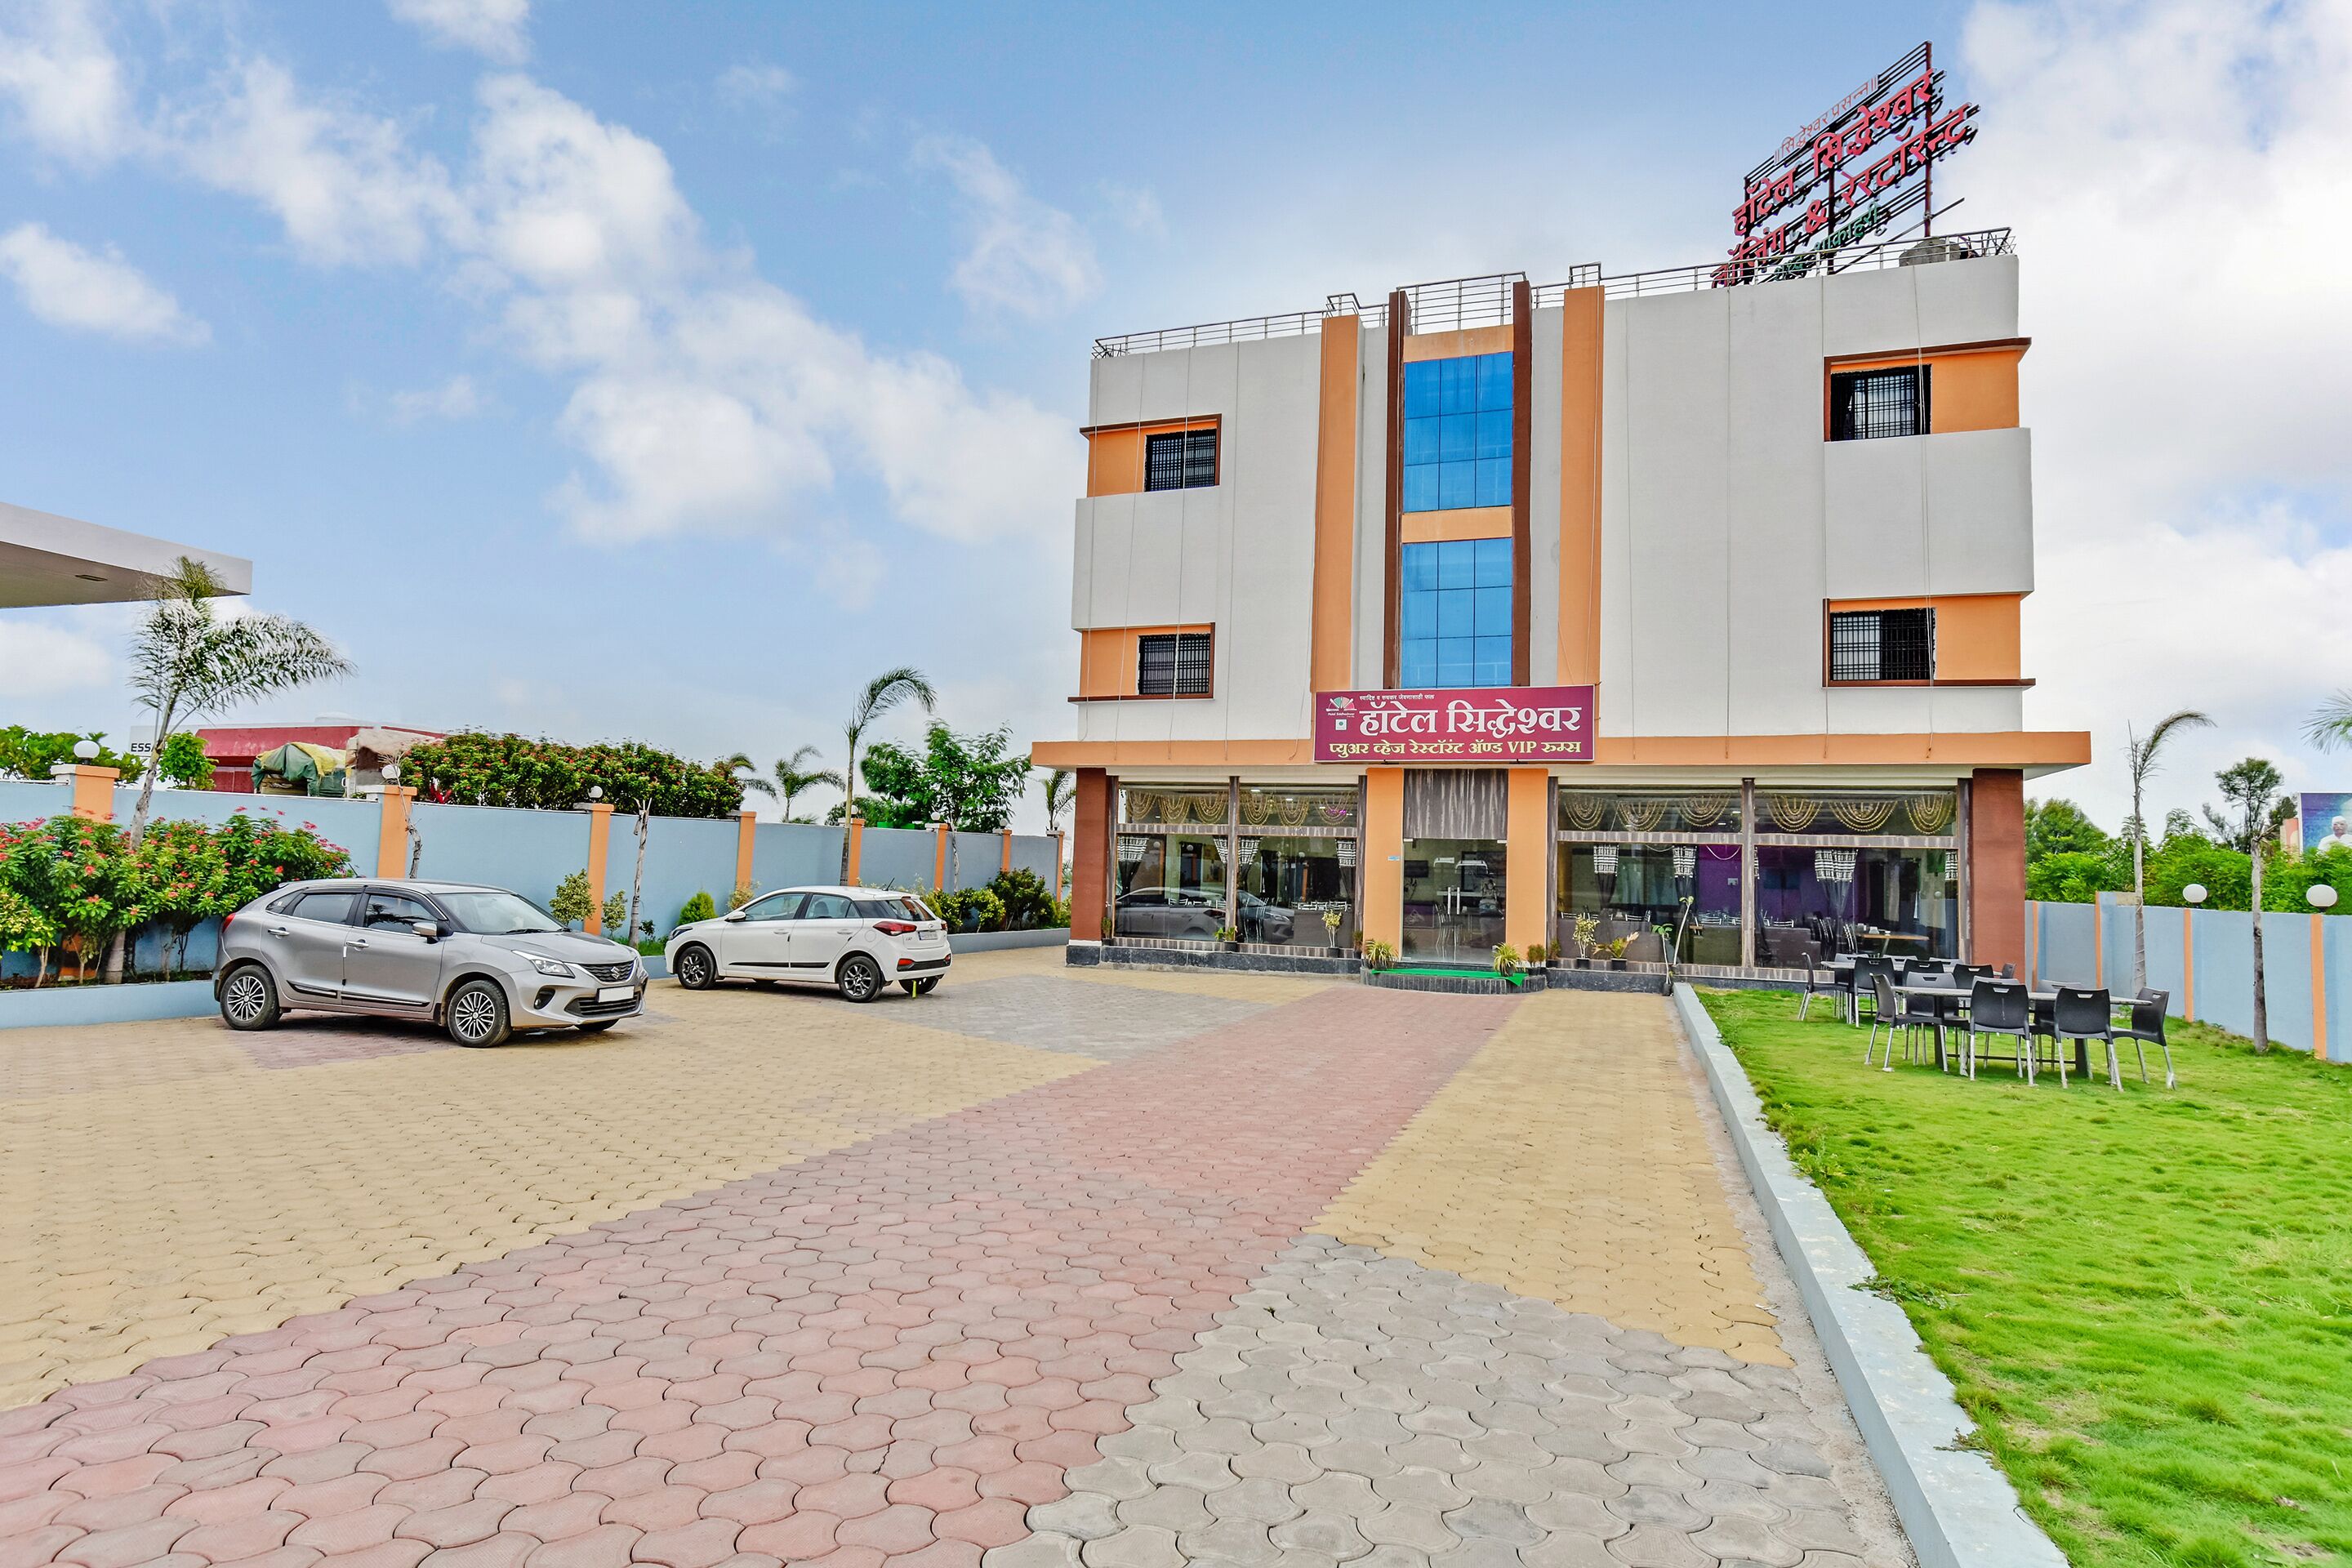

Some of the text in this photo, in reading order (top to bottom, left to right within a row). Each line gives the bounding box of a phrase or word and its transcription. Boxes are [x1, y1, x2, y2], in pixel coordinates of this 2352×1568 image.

[1731, 166, 1797, 236] हॉटेल
[1805, 198, 1829, 234] &
[1359, 698, 1583, 738] हॉटेल सिद्धेश्वर
[131, 742, 154, 752] ESS
[1330, 742, 1370, 758] प्युअर
[1373, 739, 1406, 755] व्हेज
[1409, 738, 1464, 755] रेस्टॉरंट
[1508, 741, 1537, 754] VIP
[1541, 741, 1582, 754] रुम्स
